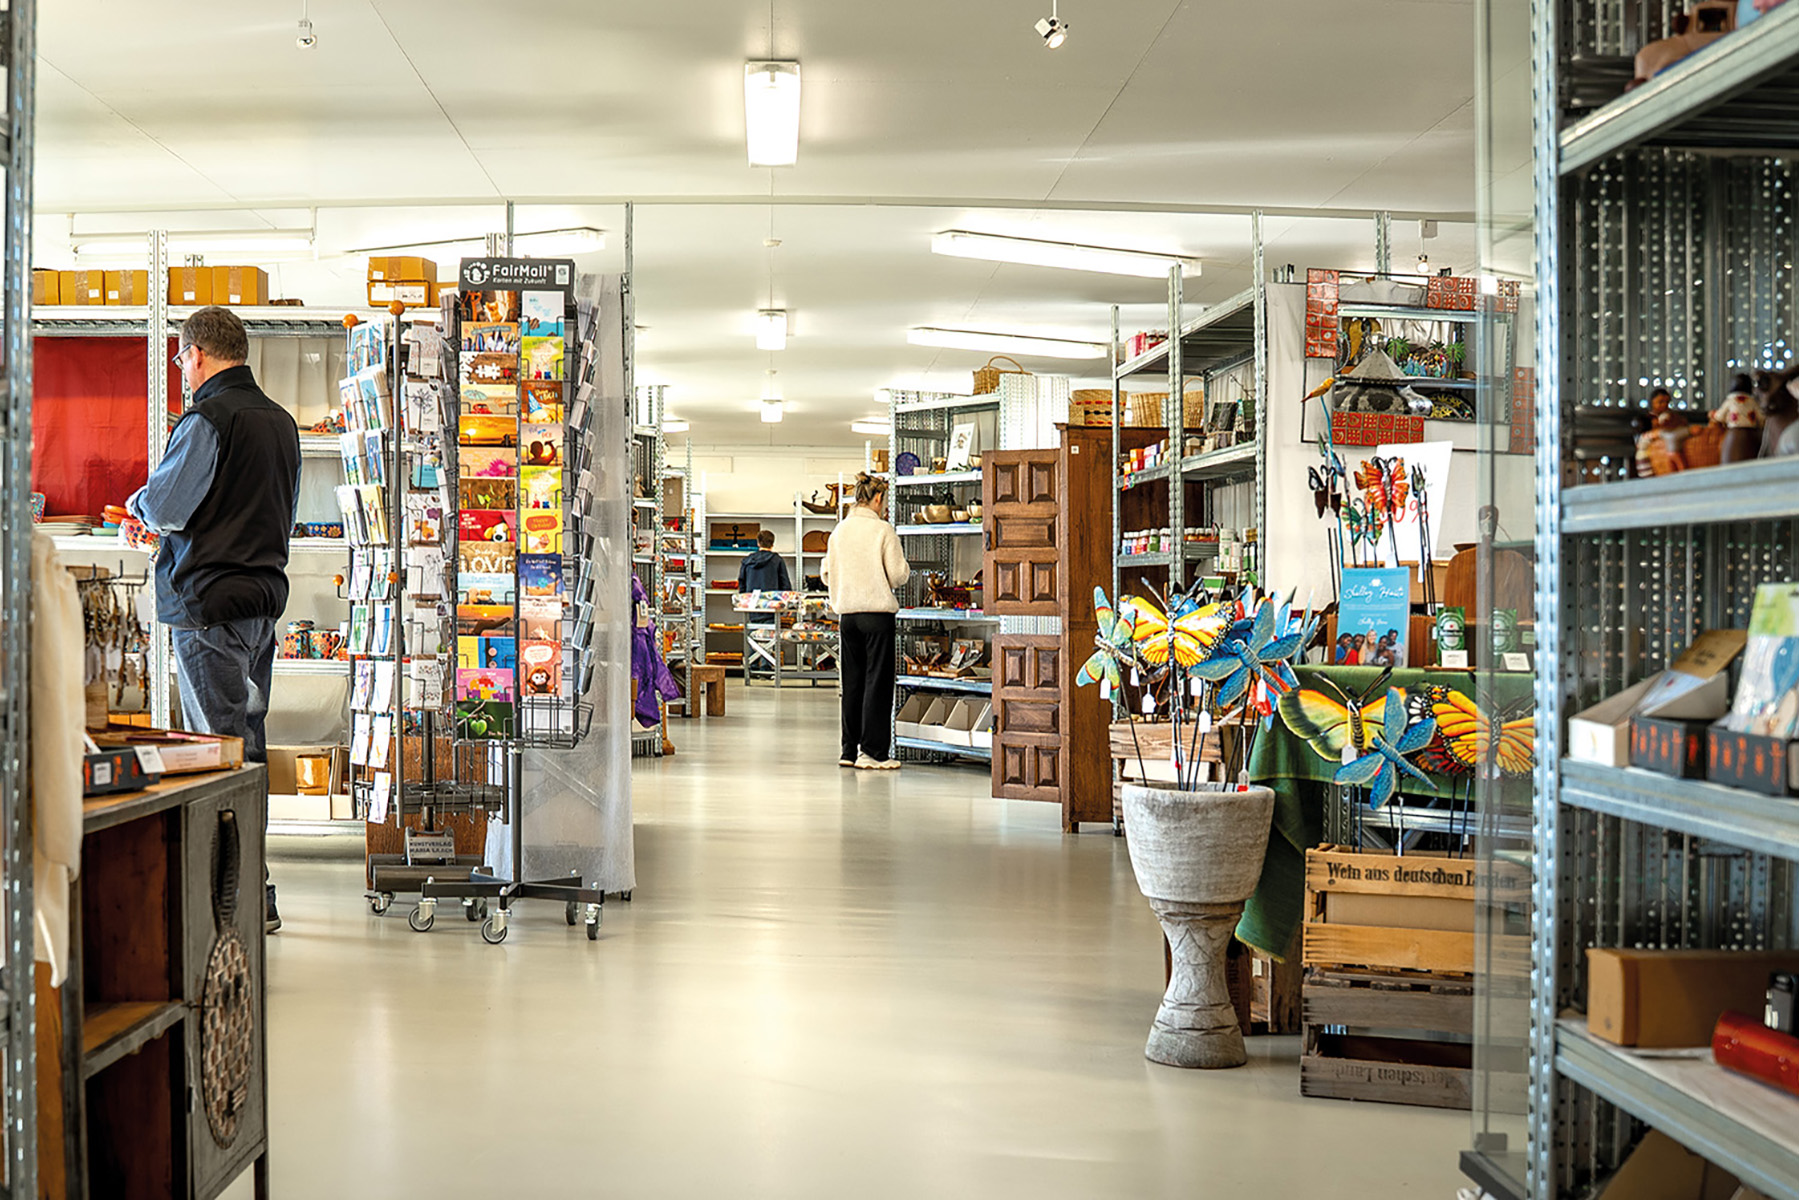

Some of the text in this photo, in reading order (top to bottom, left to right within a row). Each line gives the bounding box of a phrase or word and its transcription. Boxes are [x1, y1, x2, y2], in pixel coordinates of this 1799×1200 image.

[492, 264, 547, 277] FairMail
[1326, 861, 1361, 880] Wein
[1365, 868, 1389, 881] aus
[1394, 865, 1463, 886] deutschen
